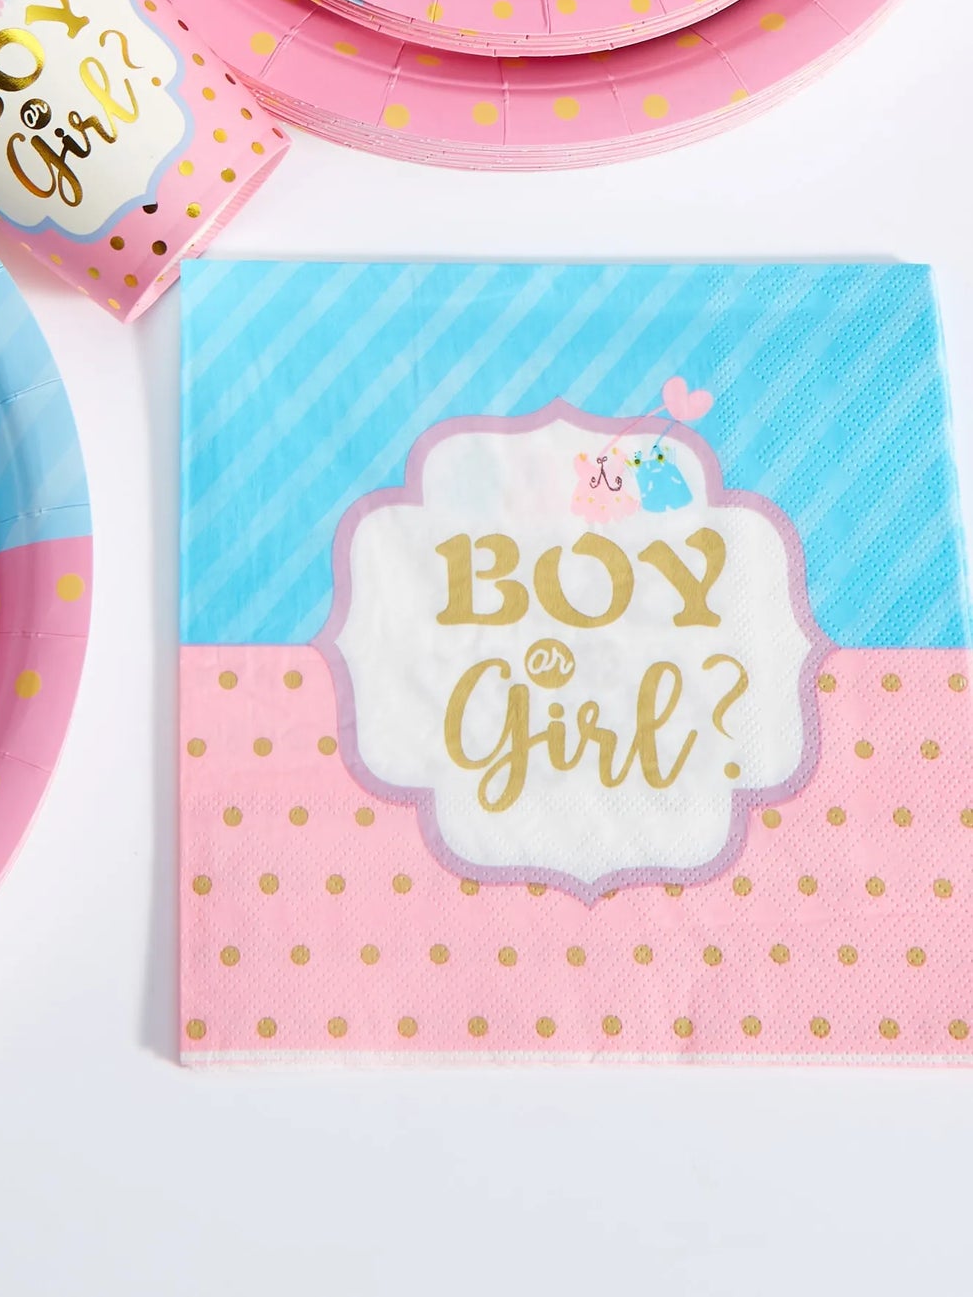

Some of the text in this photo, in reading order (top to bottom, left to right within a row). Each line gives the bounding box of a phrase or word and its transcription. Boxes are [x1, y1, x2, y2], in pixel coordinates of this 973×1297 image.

[6, 29, 161, 207] Girl?
[23, 101, 48, 128] or
[435, 527, 726, 628] BOY
[527, 647, 573, 675] or
[444, 654, 749, 813] Girl?
